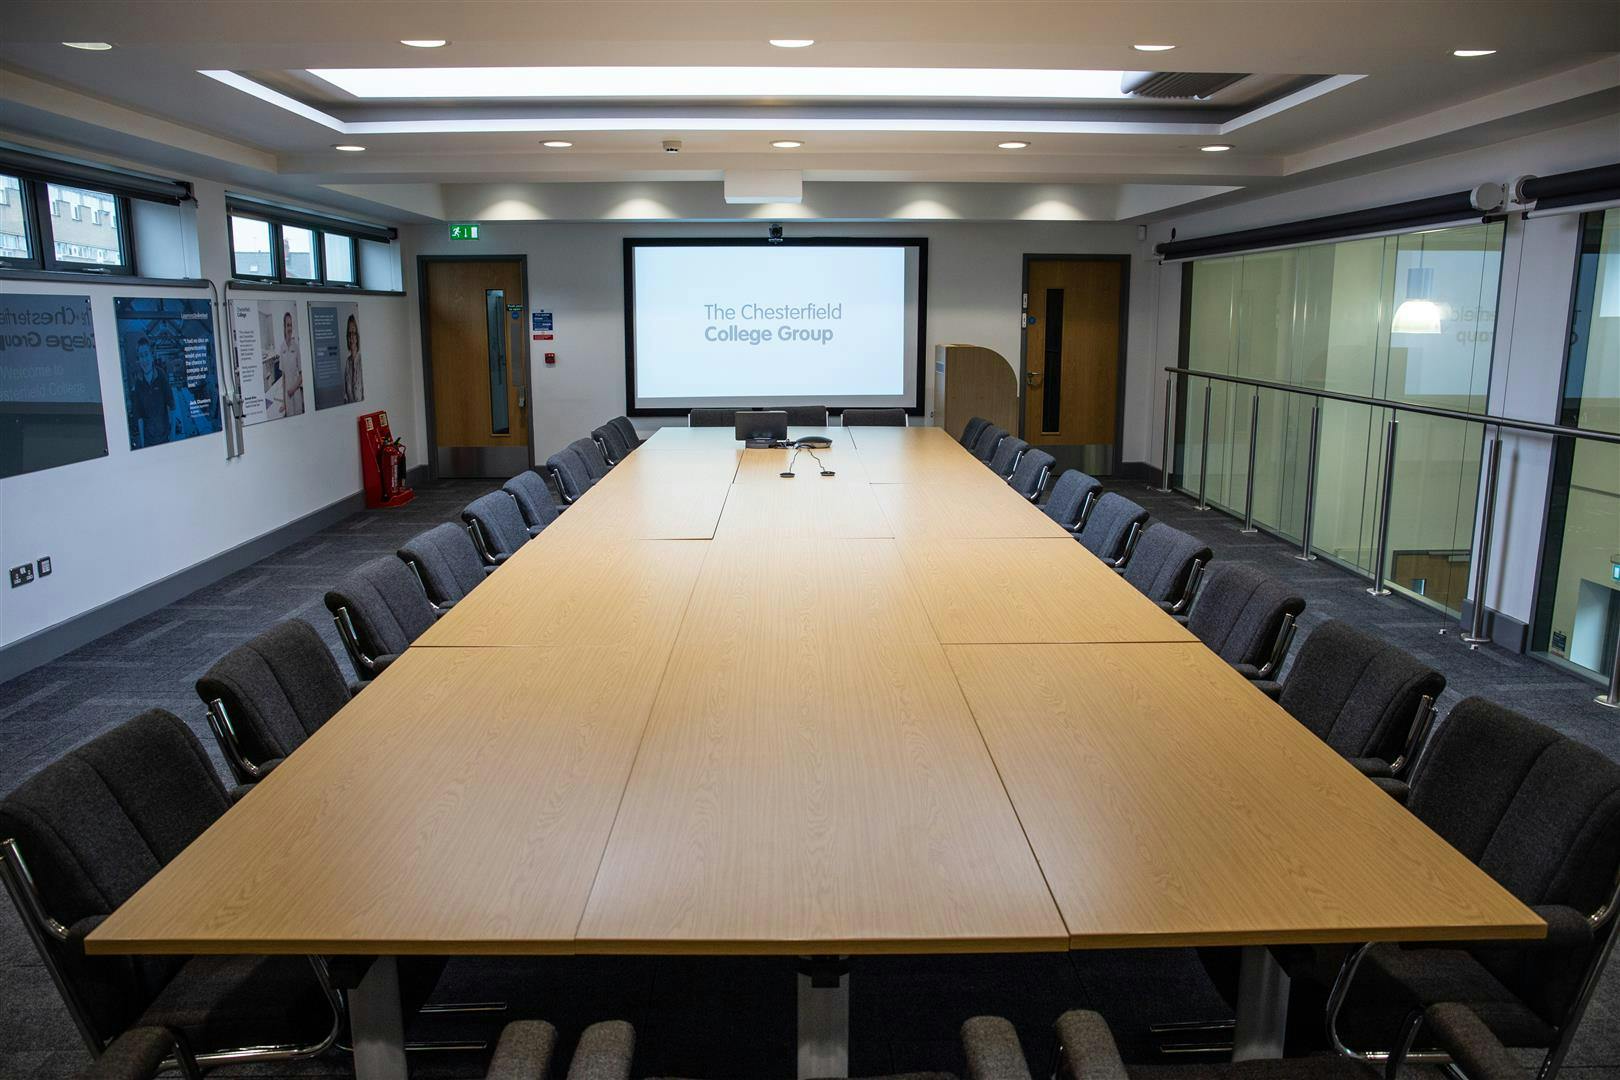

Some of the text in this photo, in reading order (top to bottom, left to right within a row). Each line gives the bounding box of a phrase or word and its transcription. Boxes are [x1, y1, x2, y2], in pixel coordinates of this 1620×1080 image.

[704, 302, 842, 320] The Chesterfield
[704, 325, 834, 346] College Group
